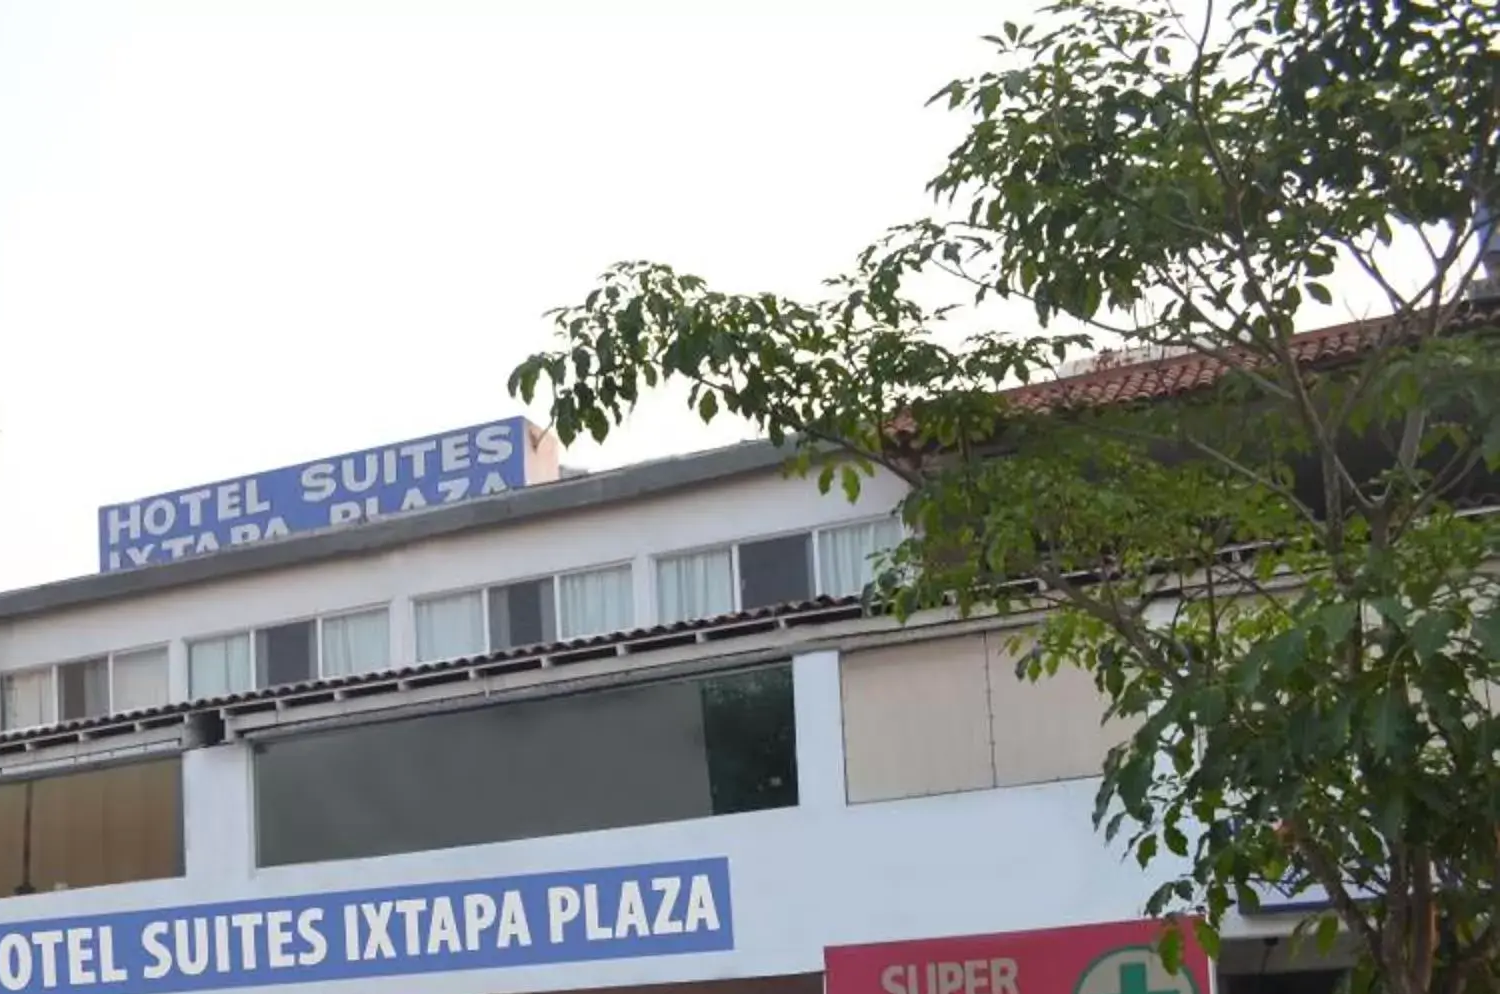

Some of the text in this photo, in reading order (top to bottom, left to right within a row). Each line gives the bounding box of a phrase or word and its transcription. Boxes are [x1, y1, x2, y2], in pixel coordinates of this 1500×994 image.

[108, 425, 513, 545] HOTEL SUITES
[142, 908, 328, 979] SUITES
[344, 890, 532, 961] IXTAPA
[548, 874, 720, 943] PLAZA
